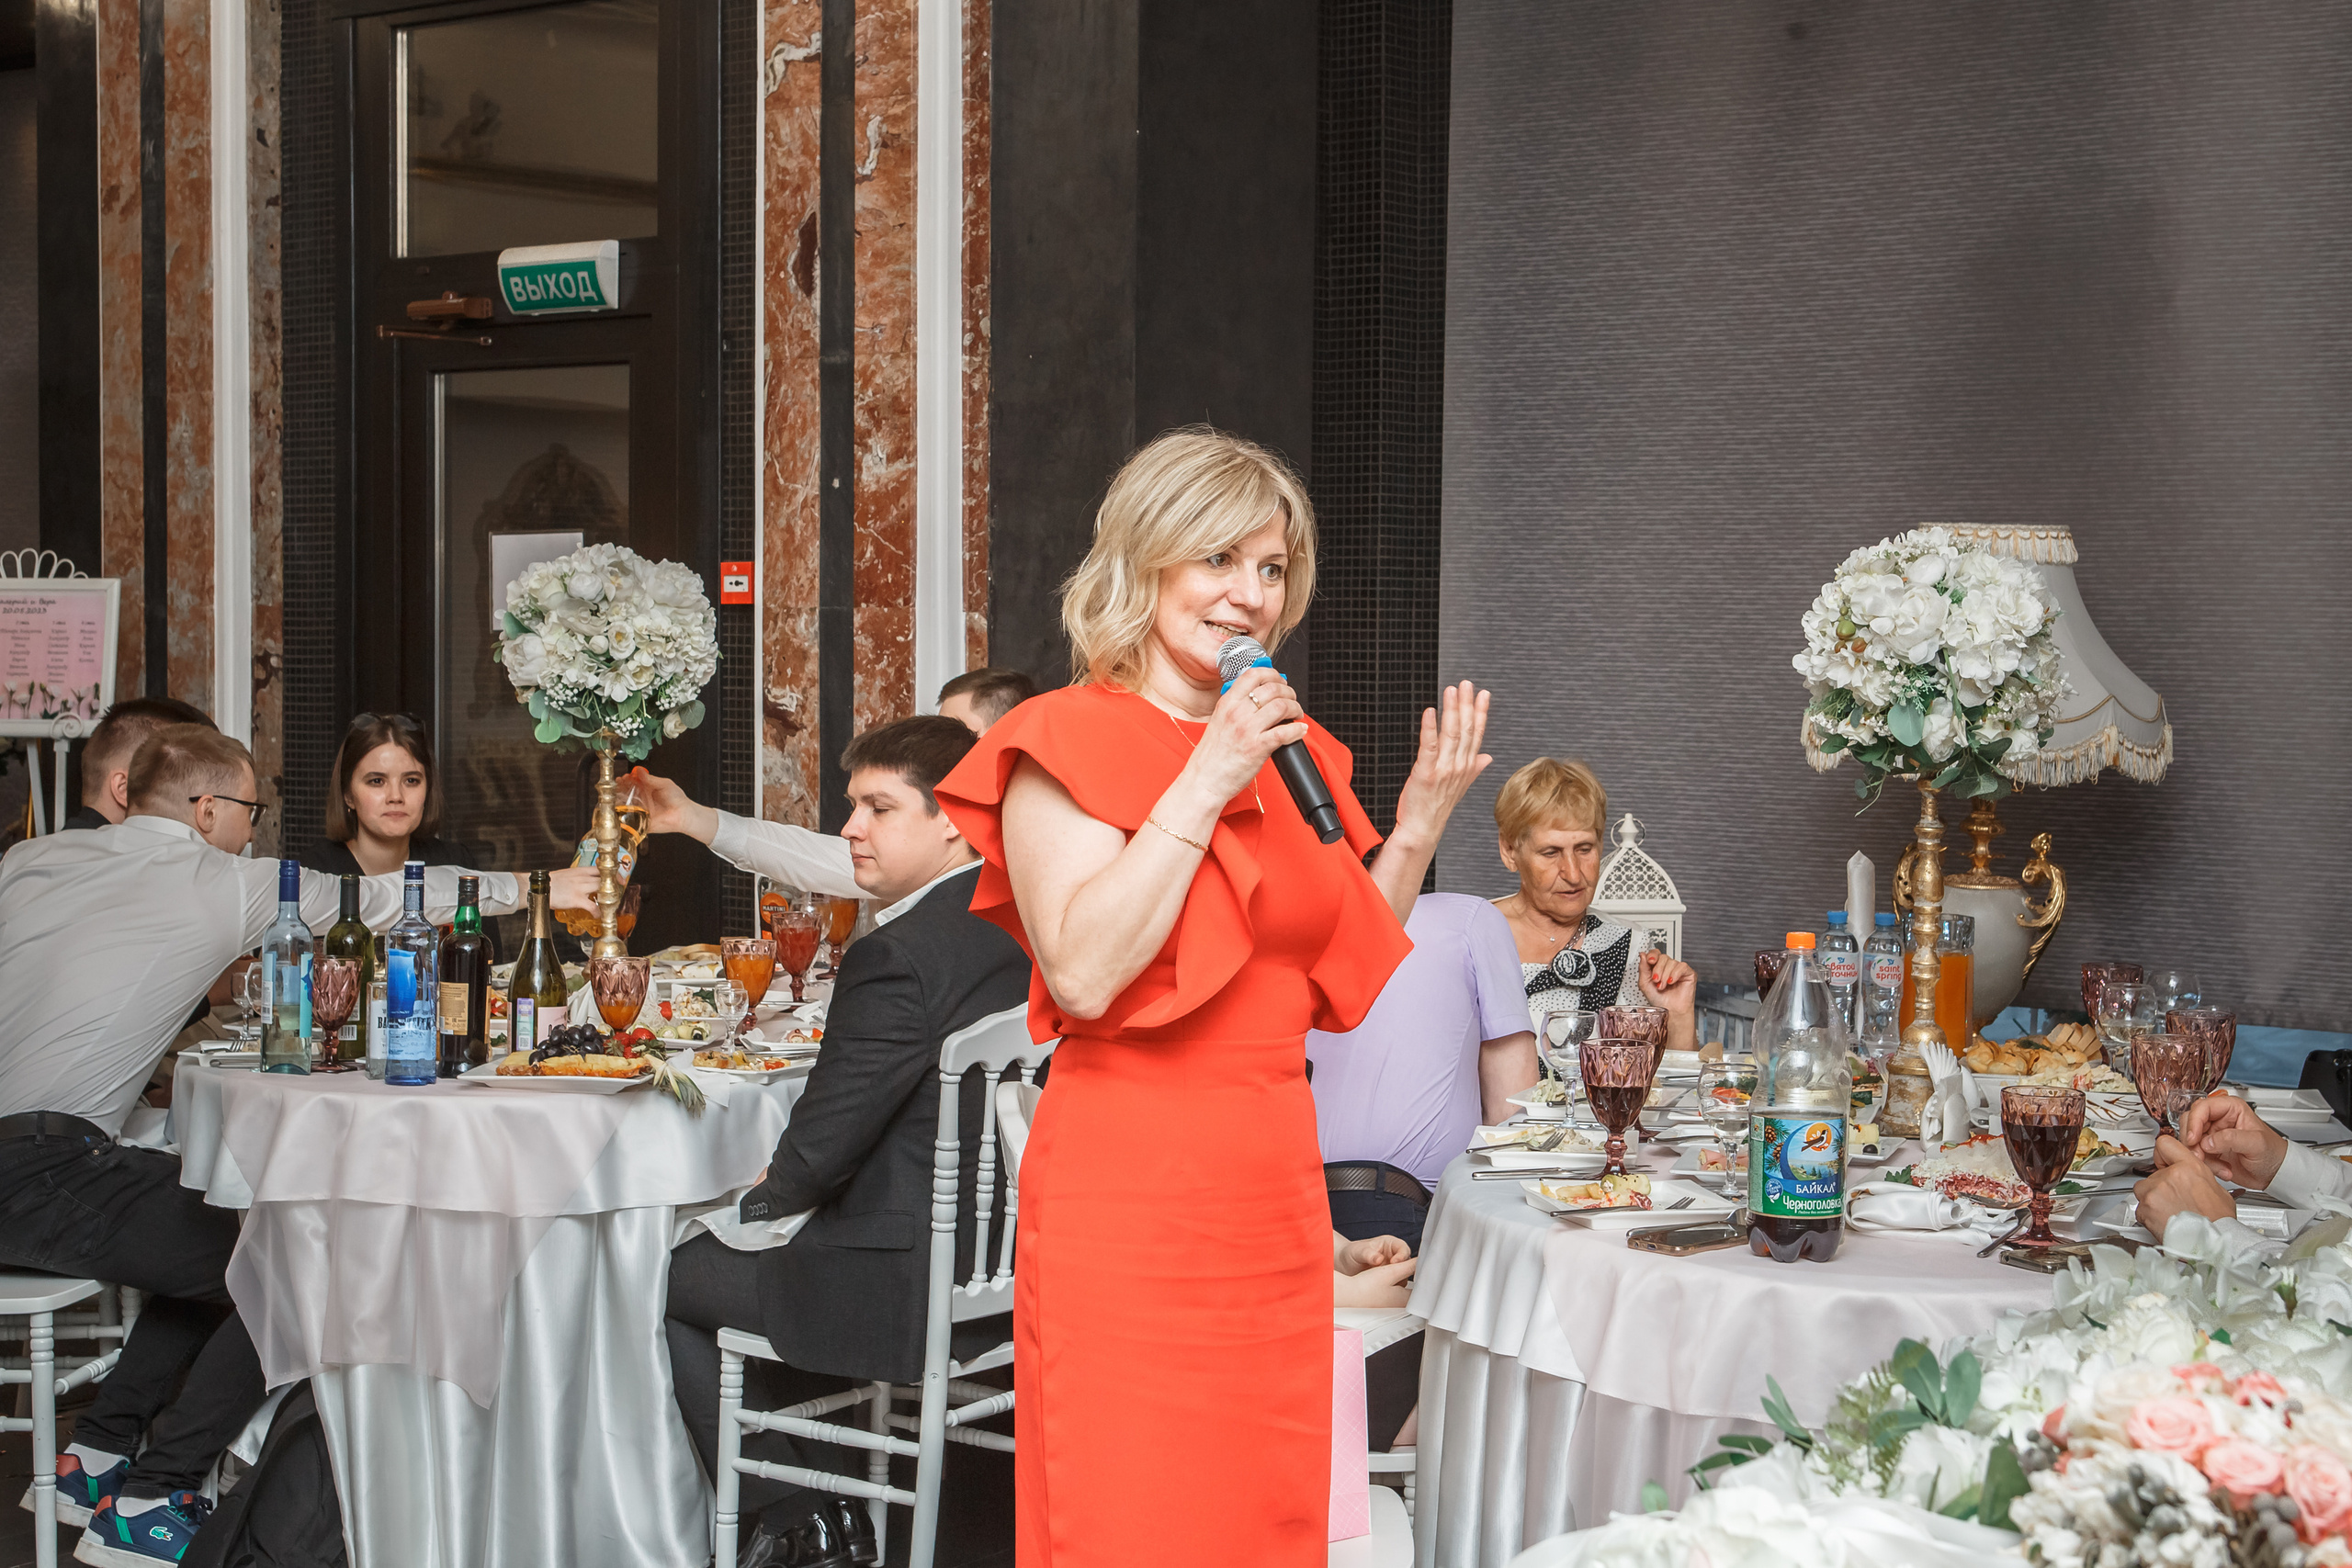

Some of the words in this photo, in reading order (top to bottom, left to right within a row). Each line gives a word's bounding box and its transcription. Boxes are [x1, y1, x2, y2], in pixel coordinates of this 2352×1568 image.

[509, 271, 598, 302] ВЫХОД
[1876, 973, 1902, 982] spring
[1796, 1182, 1835, 1193] БАЙКАЛ
[1782, 1195, 1841, 1213] Черноголовка
